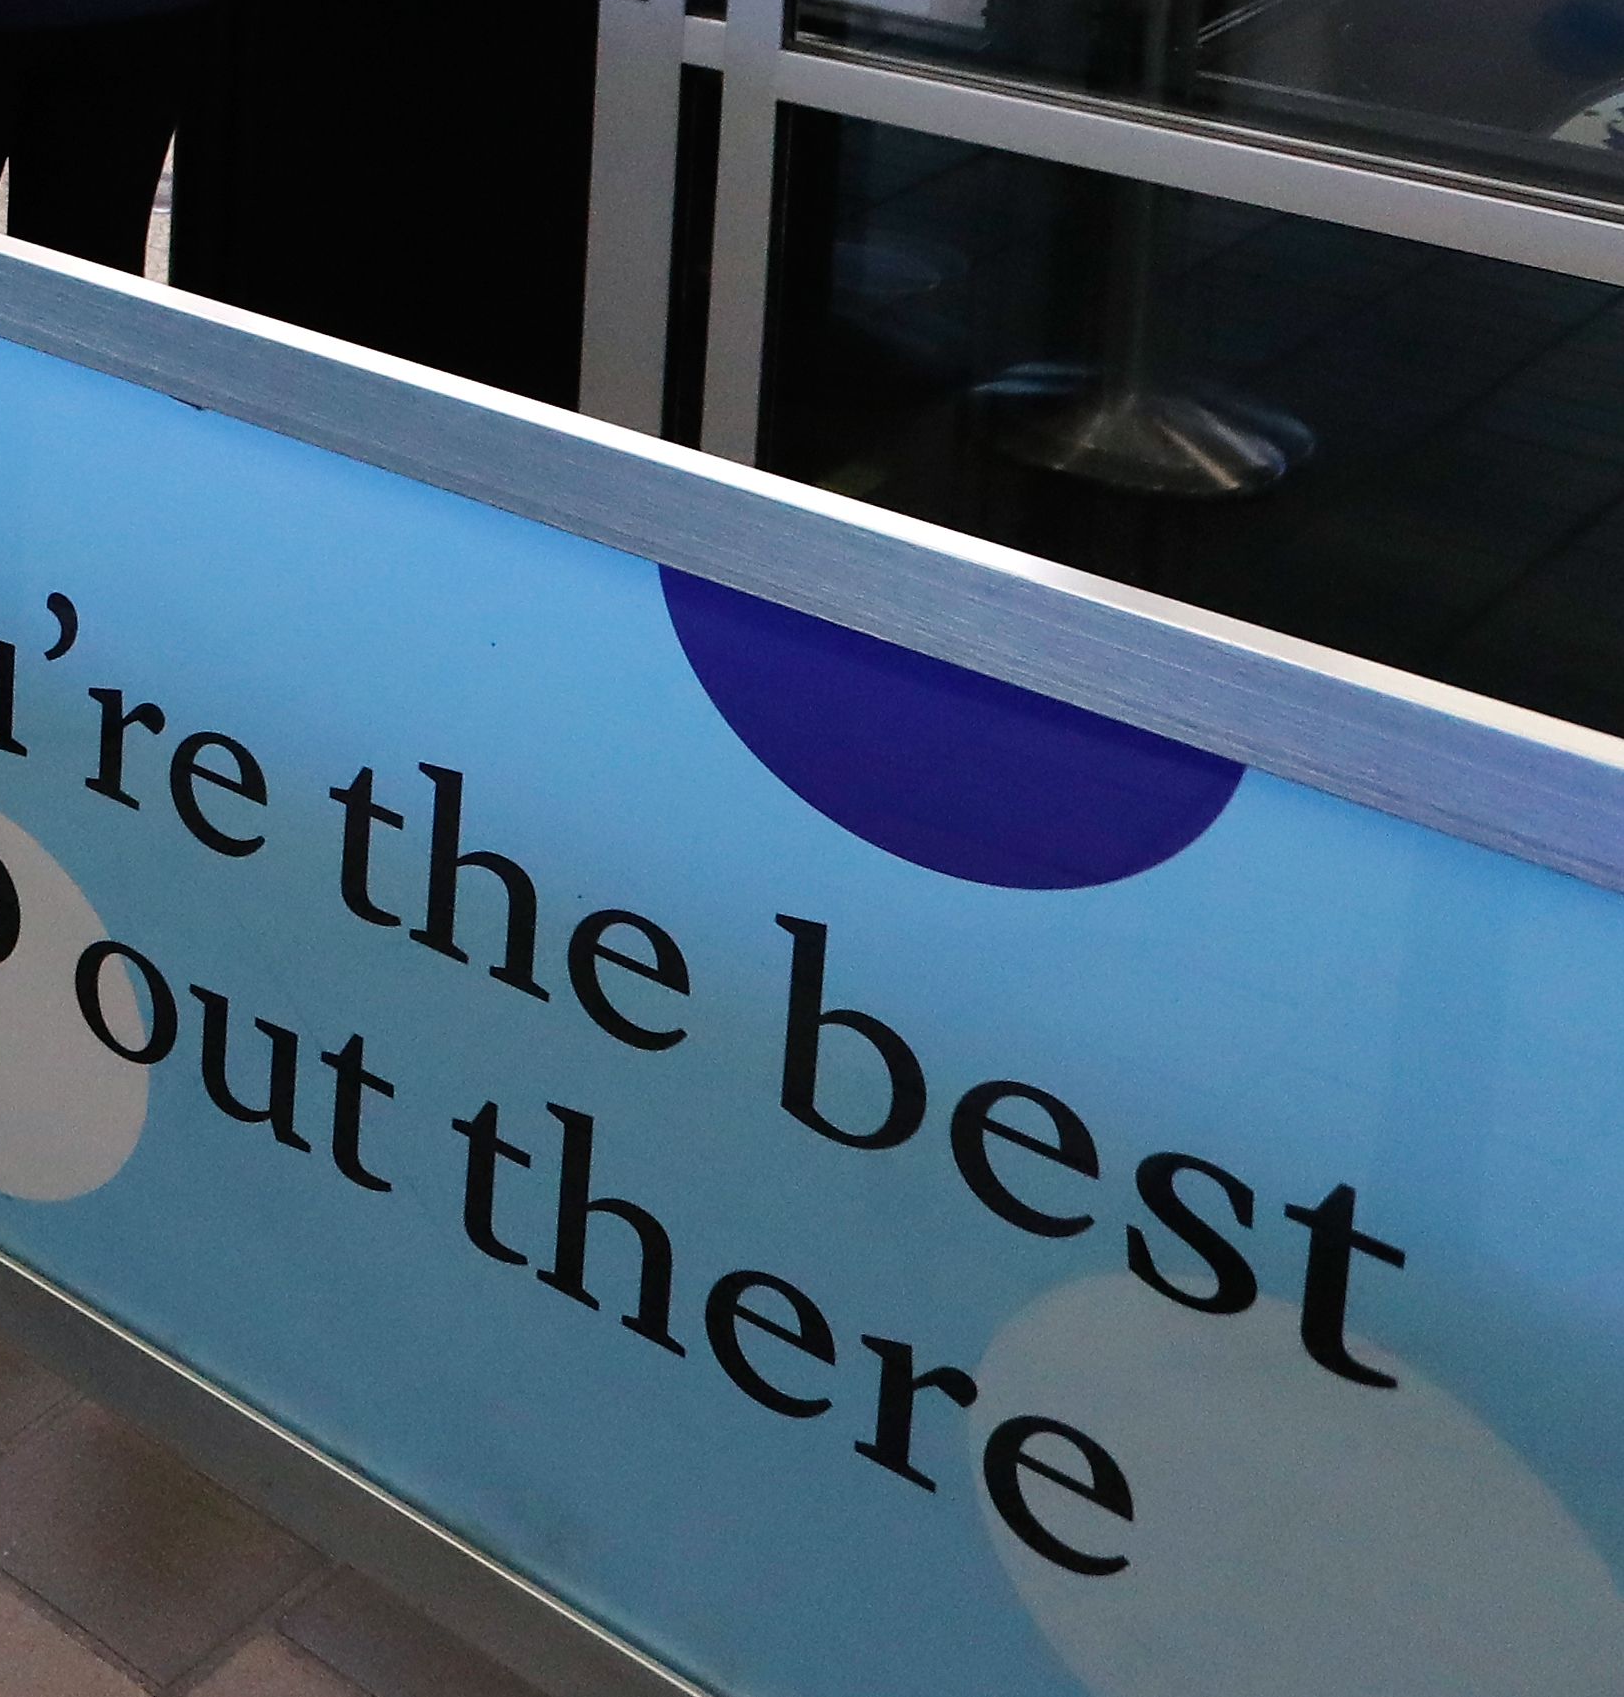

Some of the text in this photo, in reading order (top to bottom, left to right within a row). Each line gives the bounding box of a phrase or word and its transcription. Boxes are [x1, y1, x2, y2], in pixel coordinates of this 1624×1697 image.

[74, 940, 395, 1193] out
[451, 1100, 1135, 1578] there
[329, 761, 691, 1052] the
[775, 912, 1407, 1390] best
